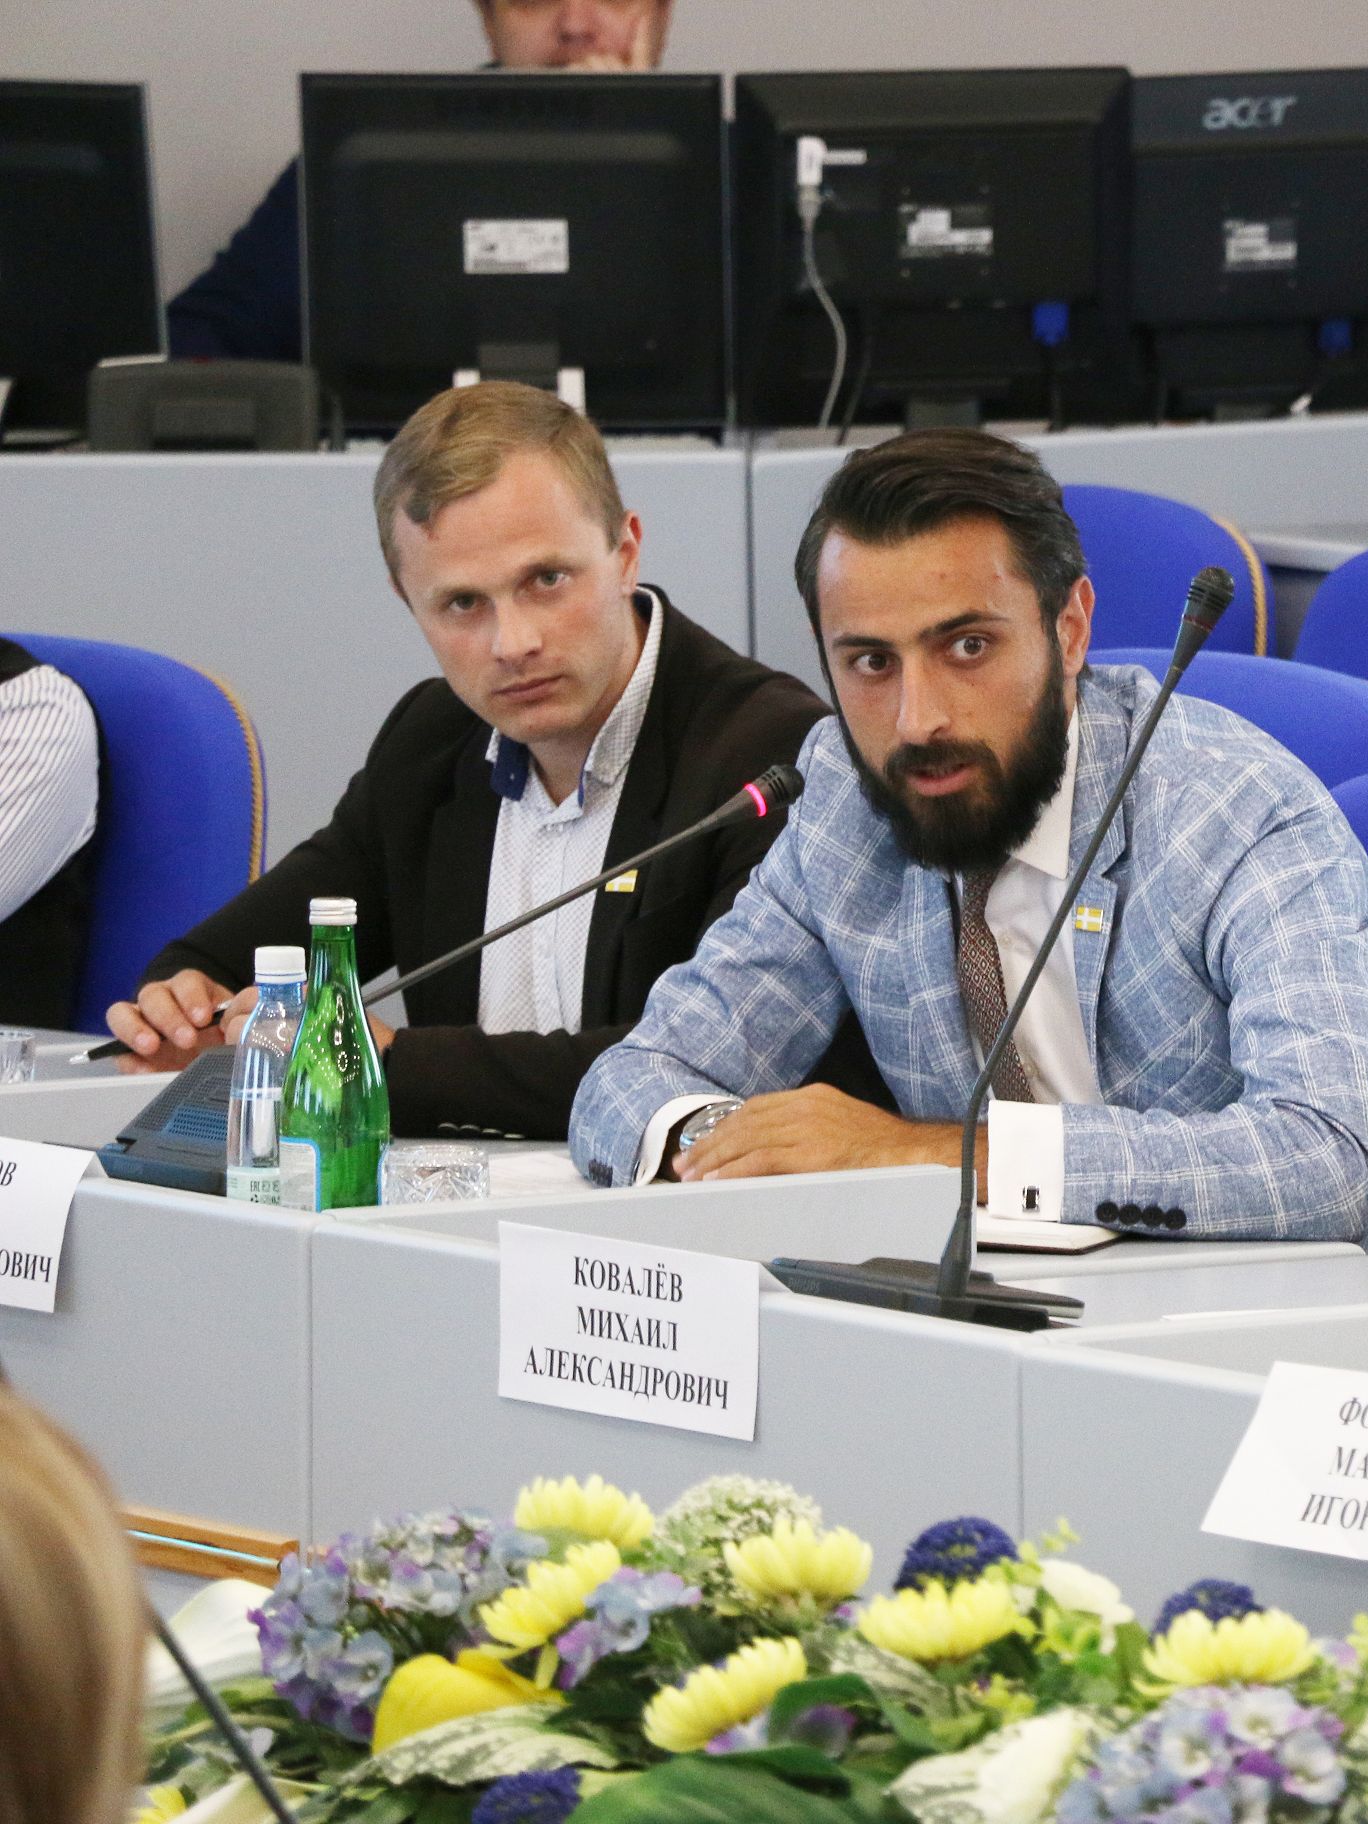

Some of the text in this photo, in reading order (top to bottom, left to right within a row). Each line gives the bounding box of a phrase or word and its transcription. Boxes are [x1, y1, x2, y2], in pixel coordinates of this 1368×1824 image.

[1202, 97, 1298, 129] acer
[573, 1256, 684, 1303] КОВАЛЁВ
[576, 1305, 679, 1352] МИХАИЛ
[523, 1346, 730, 1410] АЛЕКСАНДРОВИЧ
